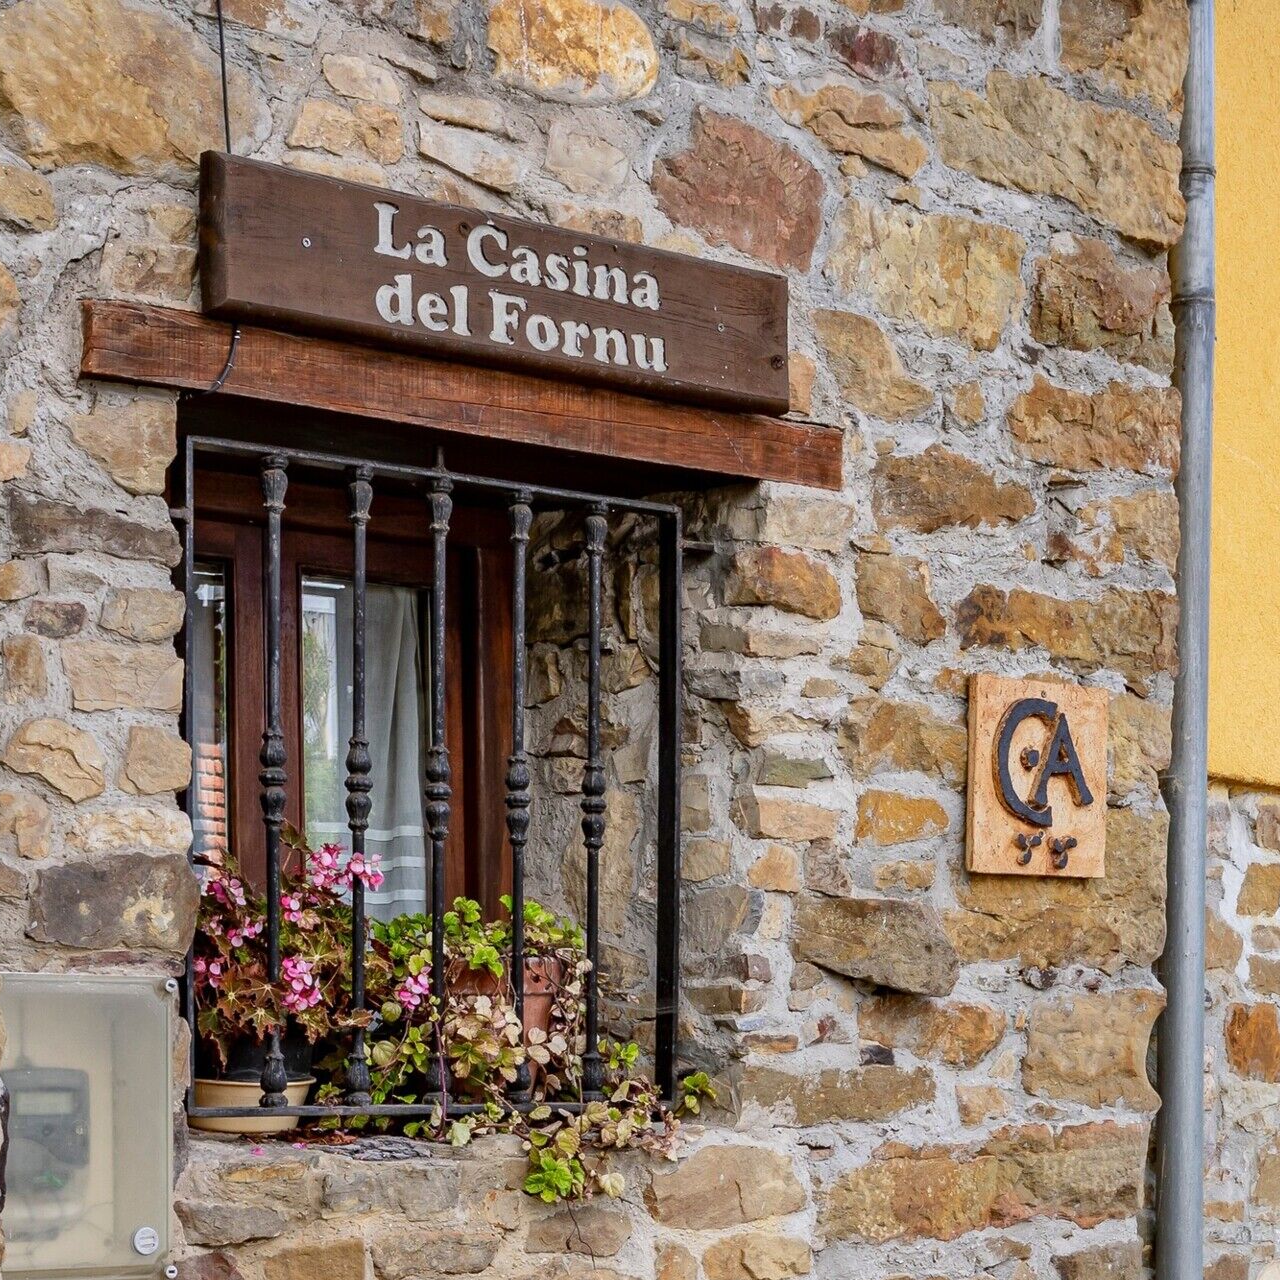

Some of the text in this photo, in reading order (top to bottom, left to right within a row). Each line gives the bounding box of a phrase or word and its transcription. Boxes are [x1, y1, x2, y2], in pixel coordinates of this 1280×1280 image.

[373, 201, 662, 311] La Casina
[375, 273, 669, 373] del Fornu
